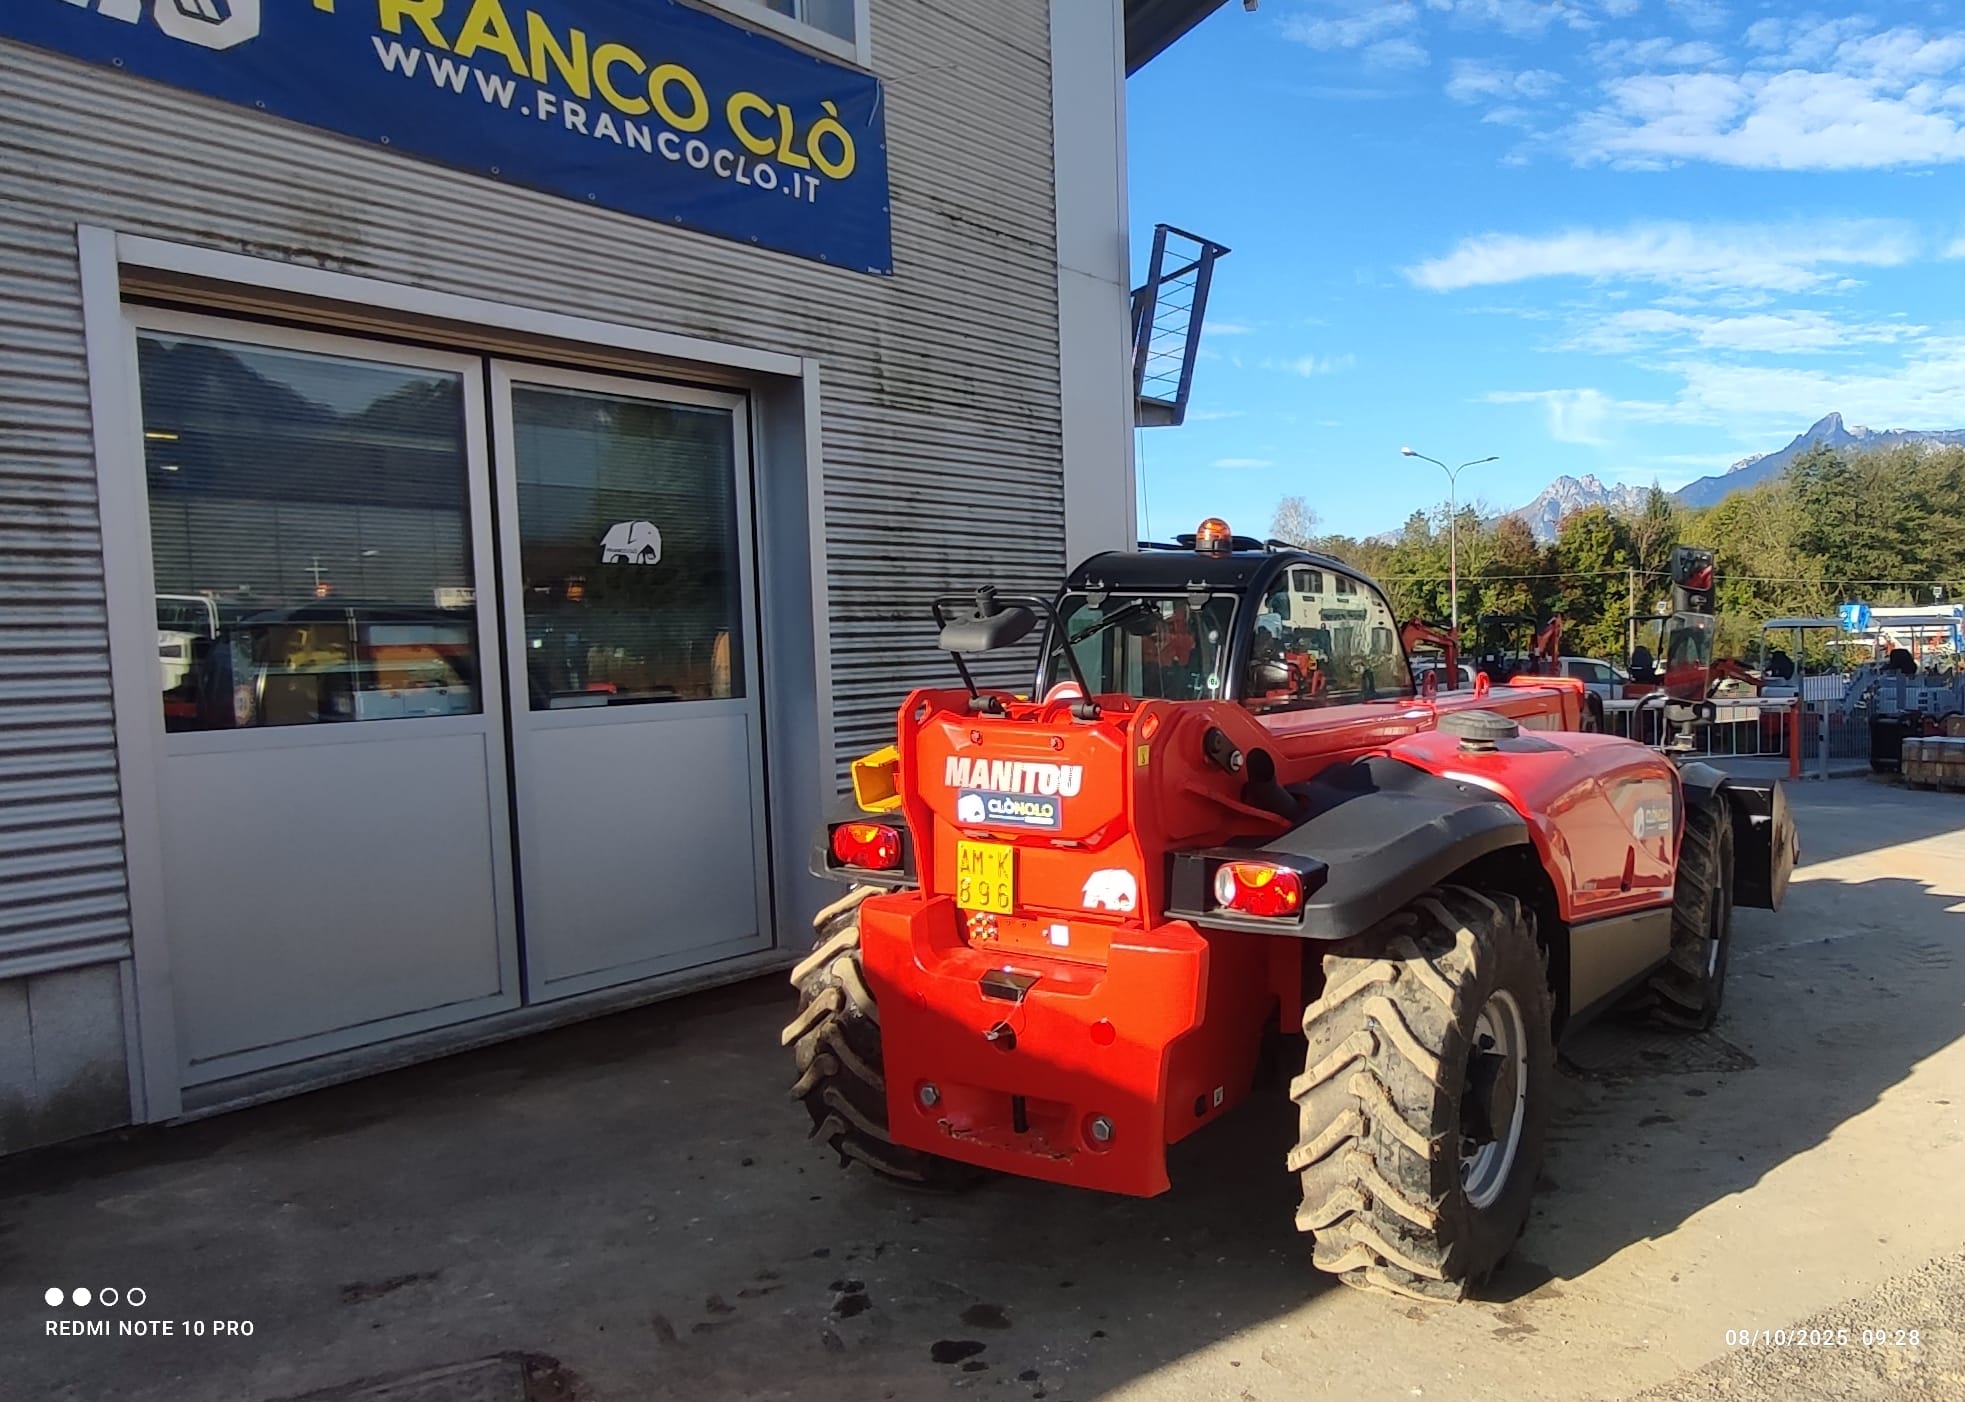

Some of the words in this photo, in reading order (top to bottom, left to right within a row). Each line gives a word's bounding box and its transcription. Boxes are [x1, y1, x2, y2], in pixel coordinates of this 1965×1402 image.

[312, 0, 709, 132] RANCO
[726, 91, 856, 179] CLÒ
[371, 36, 820, 202] WWW.FRANCOCLO.IT
[944, 756, 1083, 797] MANITOU
[960, 879, 1009, 908] 896
